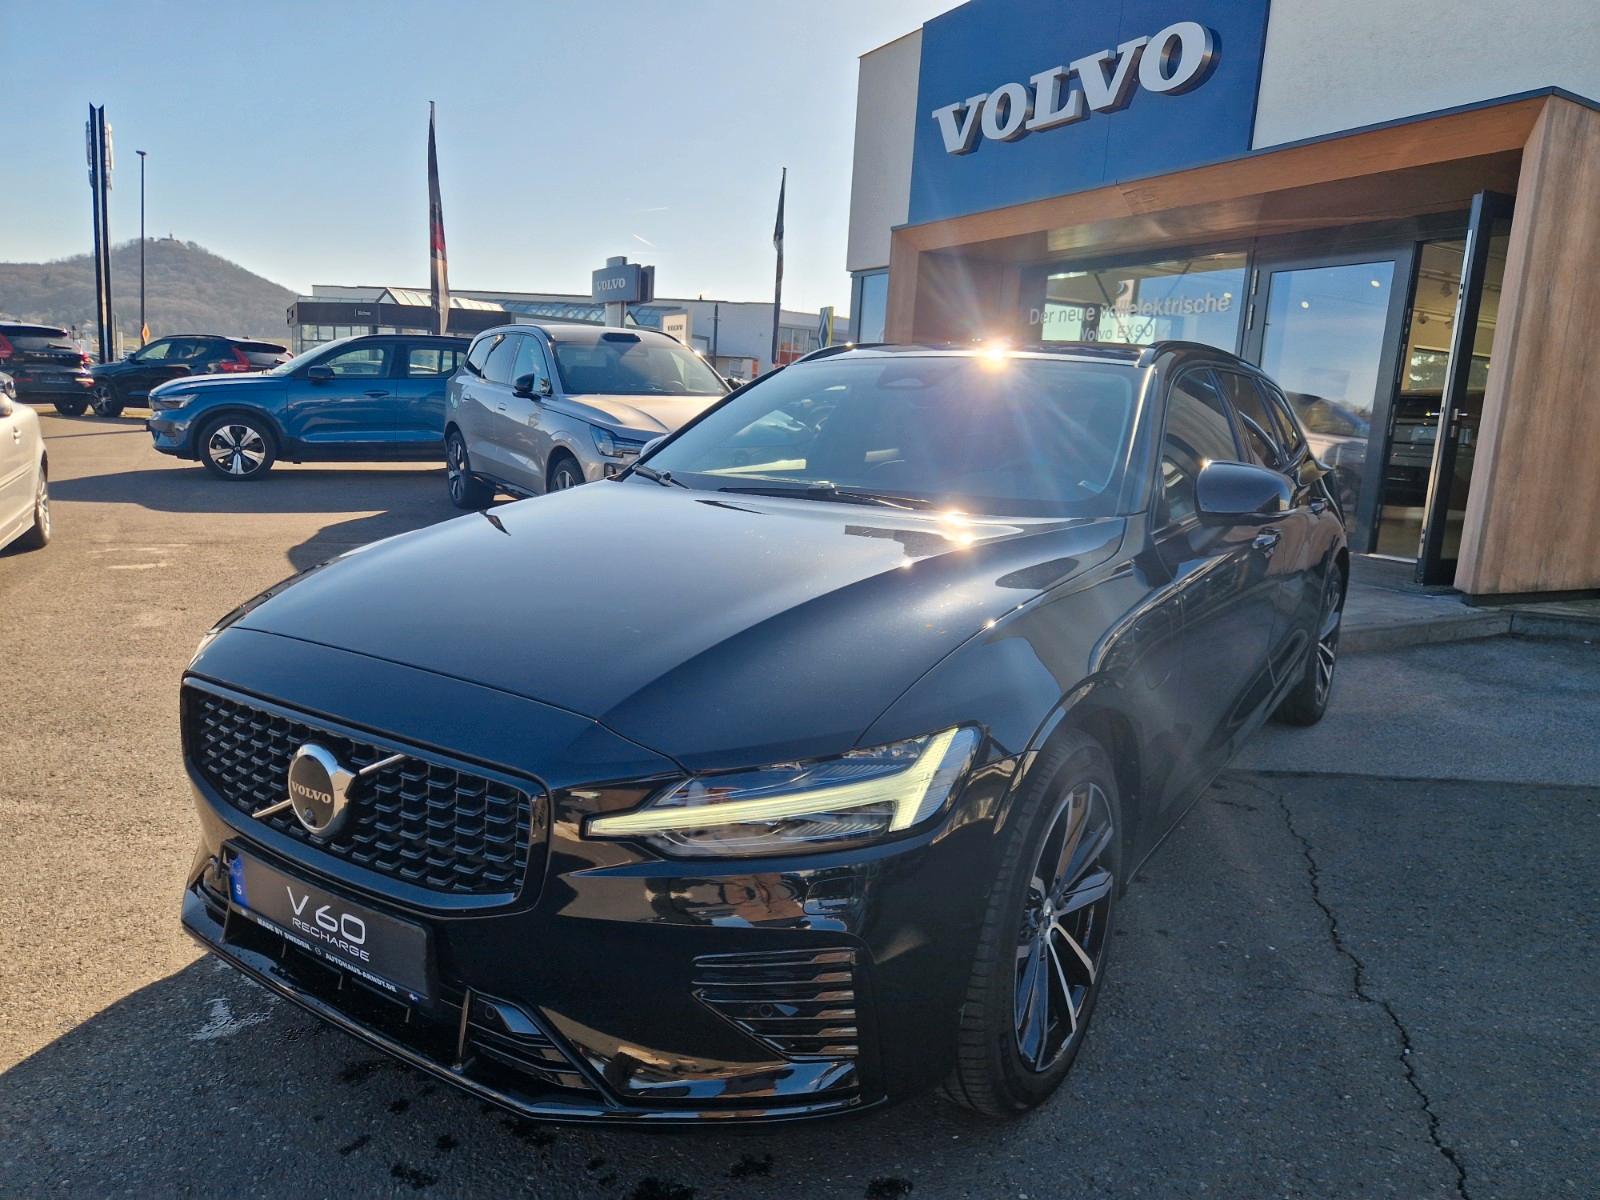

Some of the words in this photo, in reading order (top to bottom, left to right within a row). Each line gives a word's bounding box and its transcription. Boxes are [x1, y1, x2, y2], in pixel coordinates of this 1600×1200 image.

[932, 21, 1213, 155] VOLVO
[597, 278, 626, 291] VOLVO
[1029, 307, 1056, 325] Der
[1058, 305, 1095, 323] neue
[1080, 327, 1113, 342] Volvo
[1117, 324, 1154, 340] EX90
[290, 781, 332, 804] VOLVO
[292, 917, 370, 962] RECHARGE
